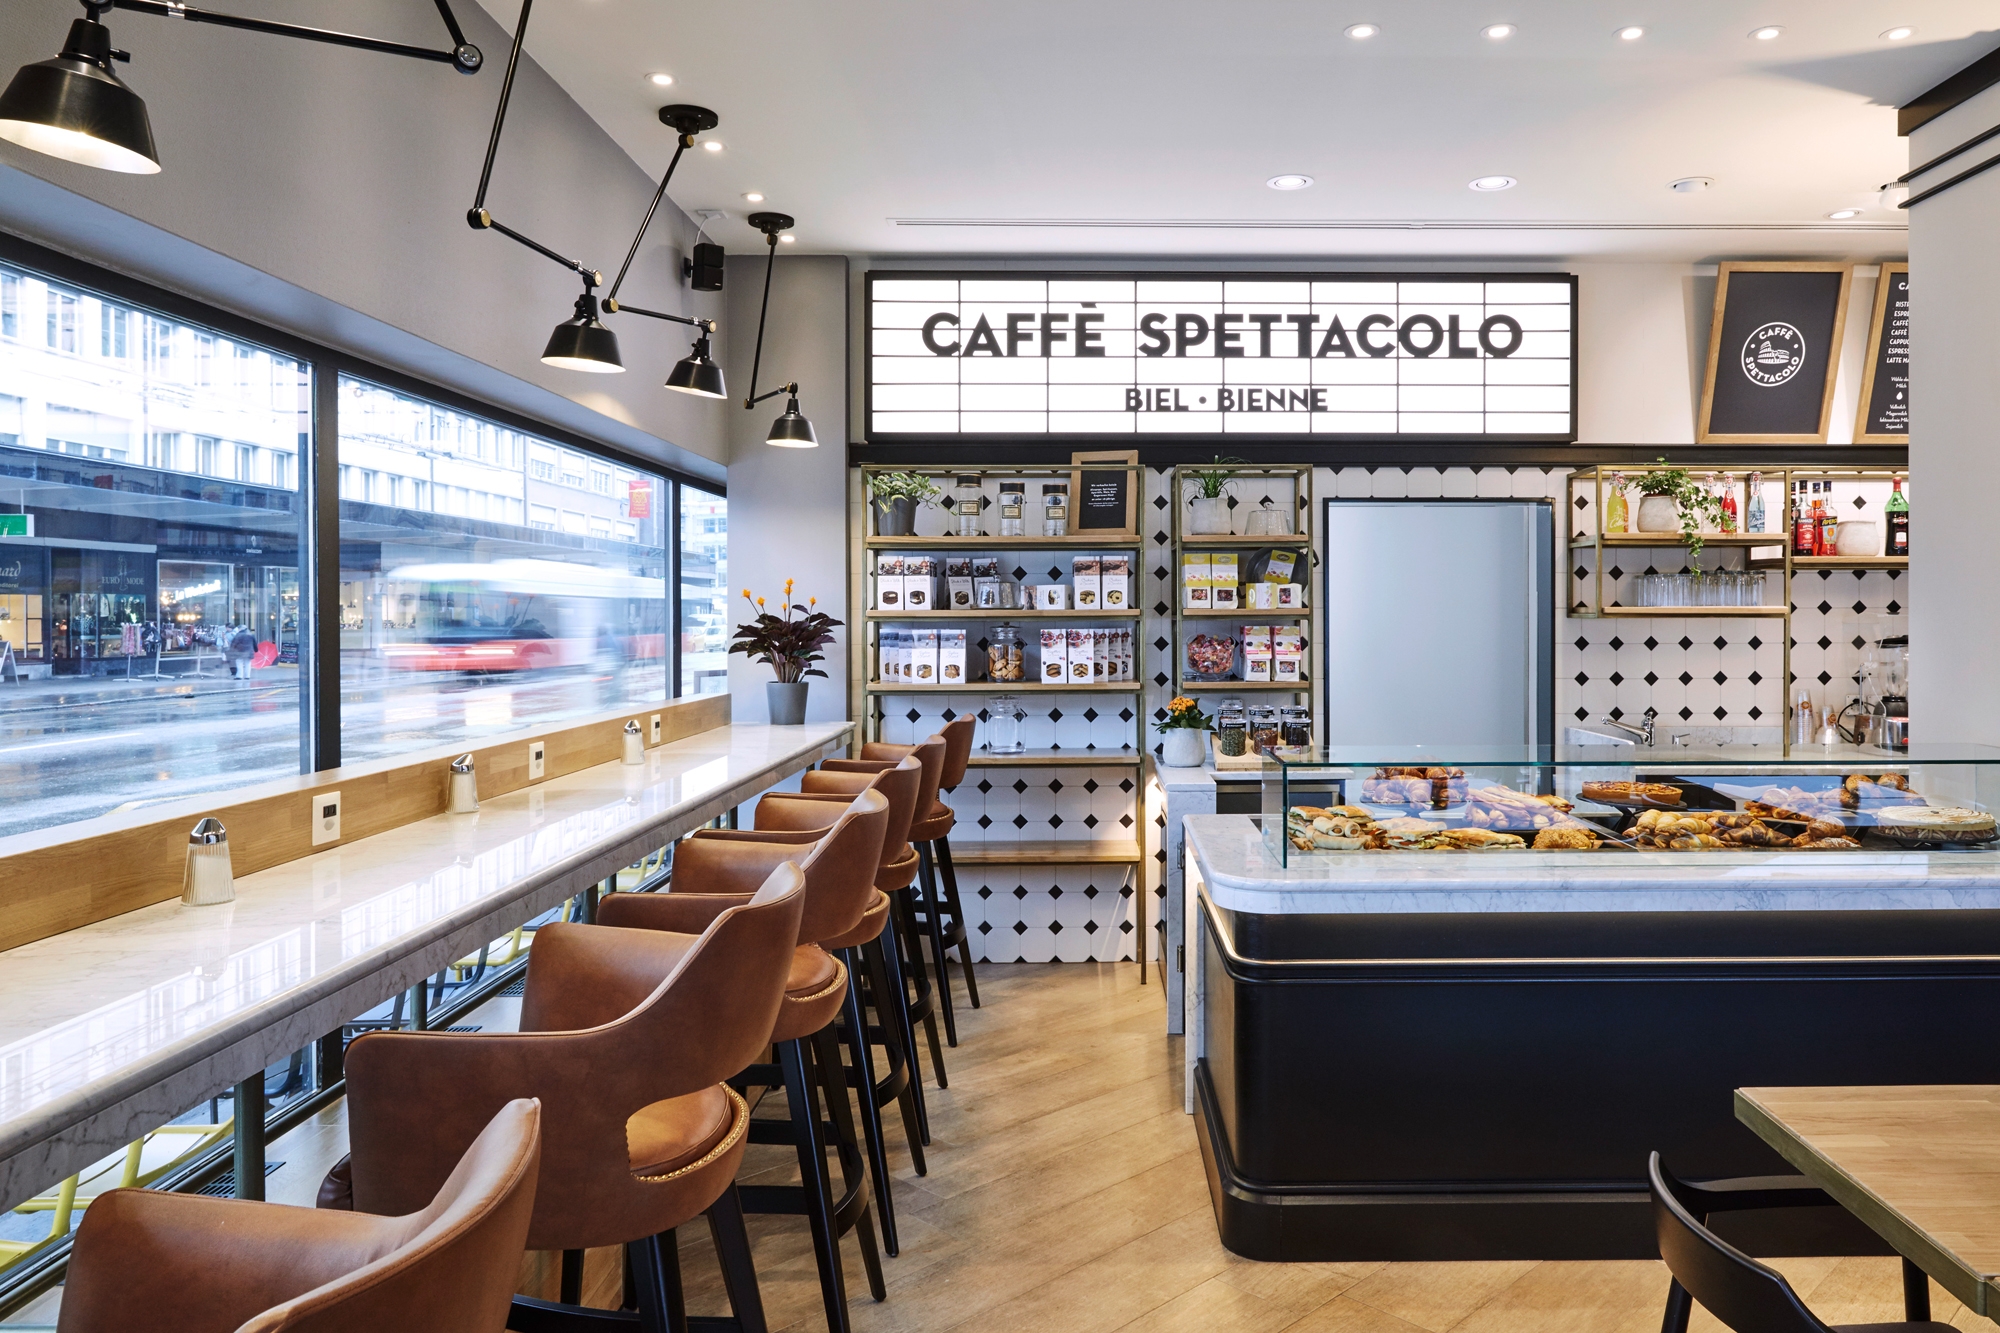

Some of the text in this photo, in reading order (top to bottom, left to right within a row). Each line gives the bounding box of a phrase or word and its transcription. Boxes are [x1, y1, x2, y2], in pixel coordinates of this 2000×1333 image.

[922, 302, 1523, 358] CAFFÈ SPETTACOLO
[1759, 327, 1794, 340] CAFFÈ
[1745, 356, 1800, 383] SPETTACOLO
[1125, 388, 1328, 412] BIEL BIENNE
